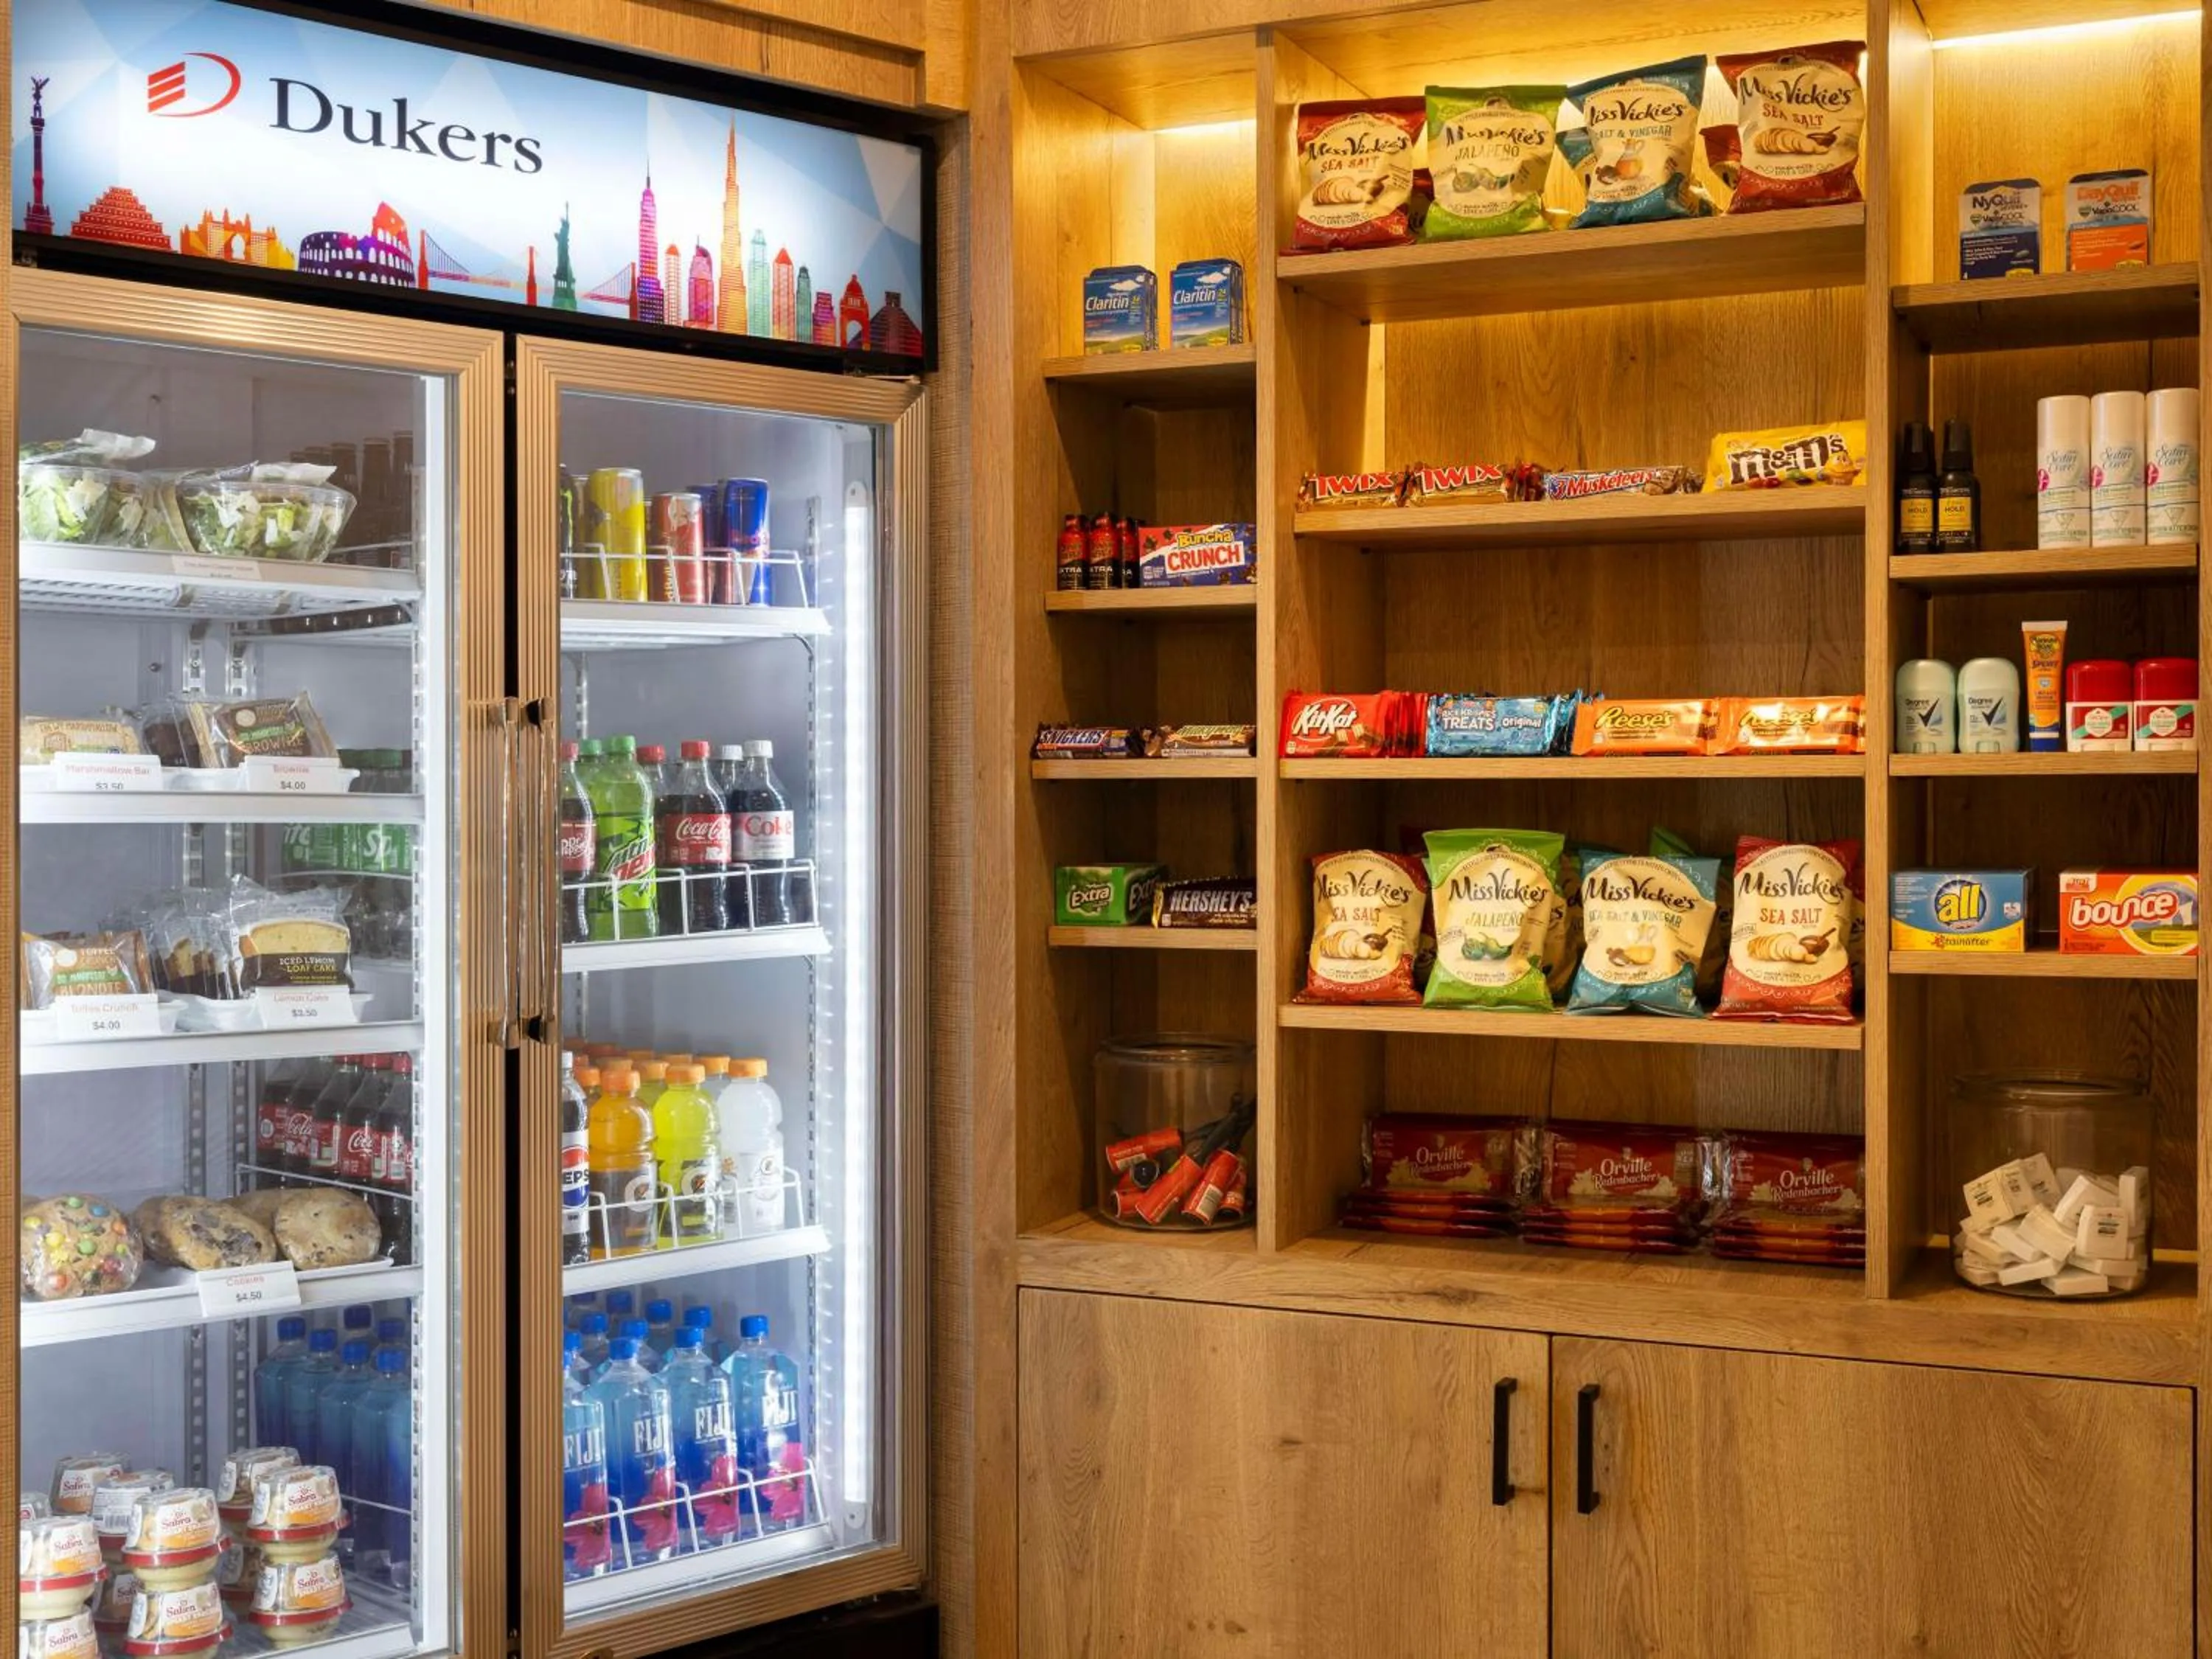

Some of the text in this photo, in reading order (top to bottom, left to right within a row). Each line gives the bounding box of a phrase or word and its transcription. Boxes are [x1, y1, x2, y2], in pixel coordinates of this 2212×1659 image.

[1778, 72, 1854, 112] Vickie's
[1616, 97, 1687, 122] Vickie's
[1762, 103, 1823, 126] SEA SALT
[268, 77, 543, 175] Dukers
[1629, 125, 1673, 138] VINEGAR
[1321, 157, 1343, 173] SEA
[1085, 293, 1130, 311] Claritin
[1173, 288, 1216, 305] Claritin
[1310, 472, 1393, 499] TWIX
[1415, 463, 1503, 494] TWIX
[1567, 470, 1654, 497] Musketeers
[1166, 544, 1240, 572] CRUNCH
[1442, 717, 1495, 731] TREATS
[1502, 716, 1543, 729] Original
[1040, 729, 1105, 745] SNICKERS
[280, 781, 306, 790] $4.00
[744, 815, 793, 838] Coke
[1072, 886, 1110, 905] Extra
[1345, 869, 1413, 908] Vickie's
[1448, 868, 1548, 908] Miss Vickie's
[1586, 875, 1698, 913] Miss Vickie's
[1739, 872, 1788, 897] Miss
[1170, 889, 1253, 913] HERSHEY'S
[1938, 883, 1982, 923] all
[2071, 892, 2174, 927] bounce
[1353, 908, 1382, 922] SALT
[1759, 908, 1823, 925] SEA SALT
[286, 964, 337, 973] LOAF CAKE
[91, 1020, 121, 1030] $4.00
[1416, 1145, 1465, 1165] Orville
[1599, 1155, 1653, 1178] Orville
[1779, 1167, 1835, 1189] Orville
[762, 1389, 797, 1429] FIJI
[565, 1427, 603, 1468] FIJI
[63, 1479, 91, 1492] Sabra
[288, 1492, 317, 1506] Sabra
[161, 1516, 192, 1529] Sabra
[166, 1604, 197, 1618] Sabra
[49, 1632, 79, 1649] Sabra
